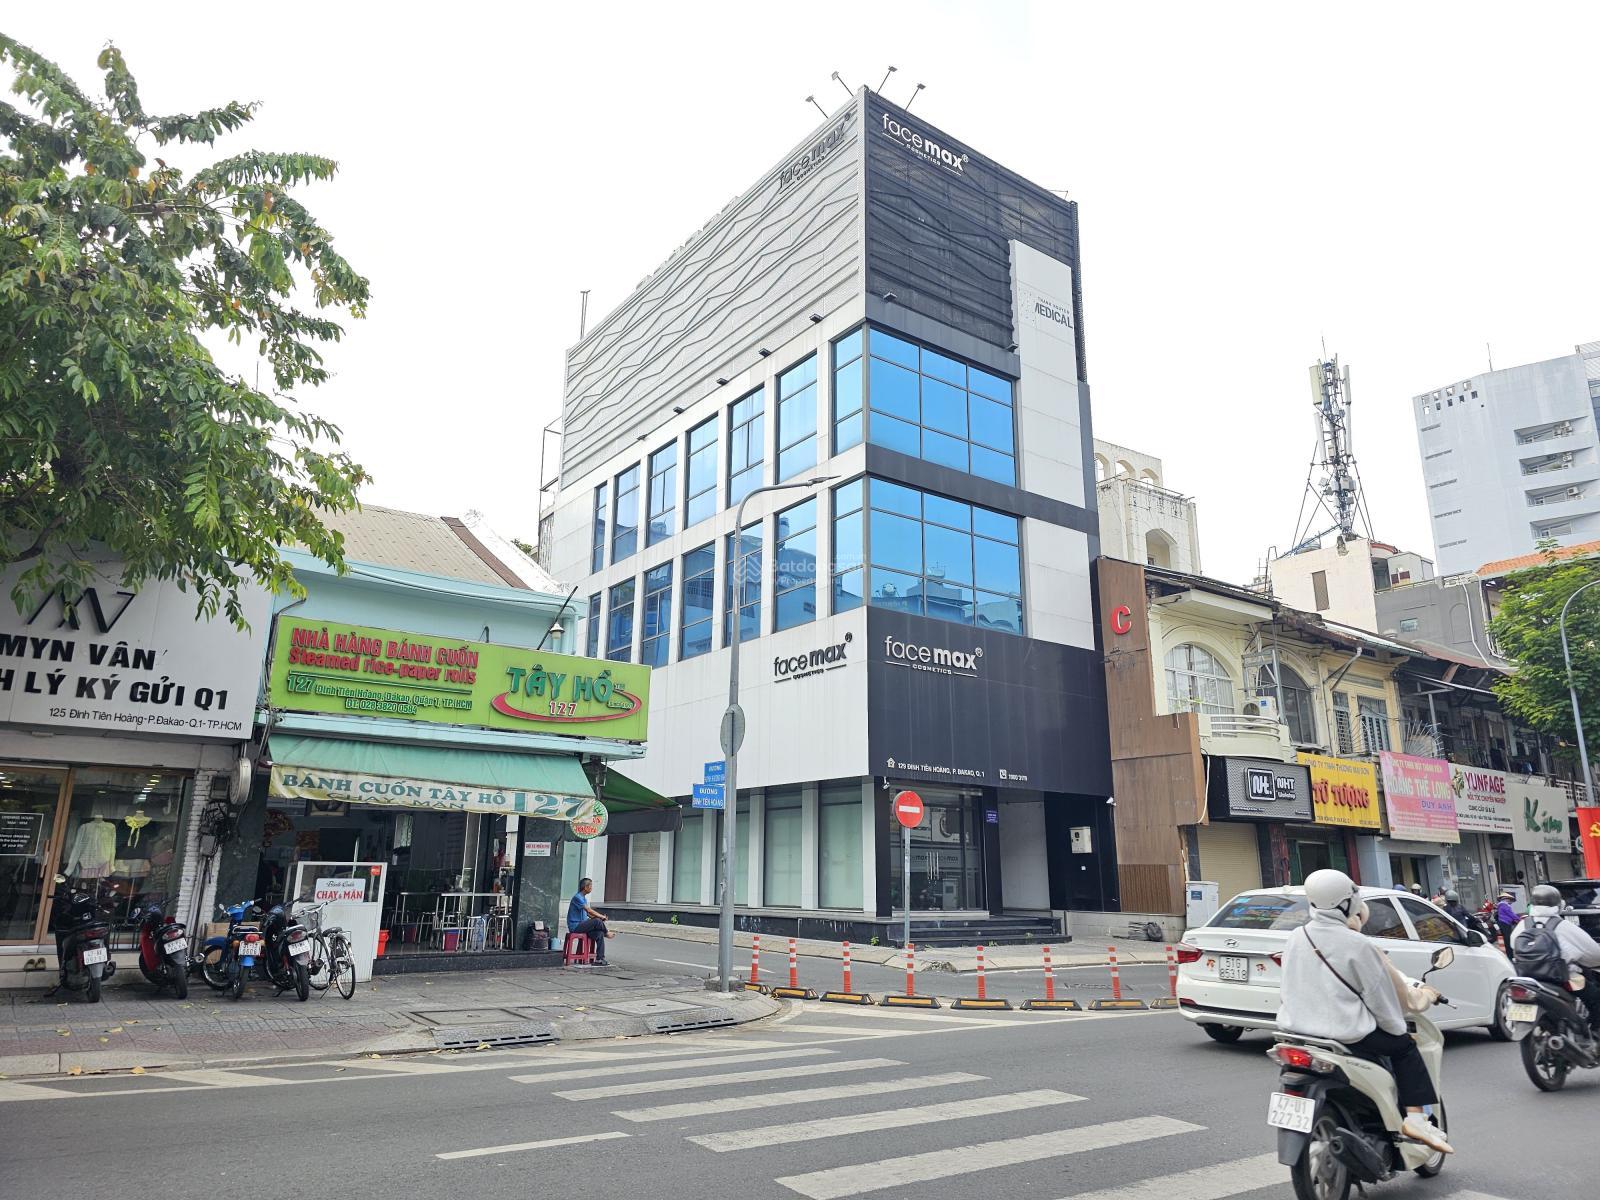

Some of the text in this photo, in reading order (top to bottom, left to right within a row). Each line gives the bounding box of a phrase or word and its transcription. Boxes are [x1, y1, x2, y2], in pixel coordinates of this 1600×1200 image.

[905, 143, 942, 167] COSMETICS
[1111, 605, 1132, 634] C
[89, 641, 156, 670] VÂN
[292, 627, 479, 669] NHÀ HÀNG BÁNH CUỐN
[289, 647, 476, 684] Steamed rice-paper rolls
[912, 663, 952, 675] COSMETICS
[24, 669, 67, 695] LÝ
[75, 674, 121, 700] KÝ
[129, 676, 185, 706] GỬI
[194, 688, 228, 711] Q1
[287, 674, 316, 693] 127
[507, 664, 566, 700] TÂY
[50, 708, 66, 718] 125
[92, 711, 112, 721] Tiên
[360, 699, 376, 711] 028
[377, 701, 397, 713] 3820
[398, 703, 417, 715] 0584
[550, 701, 577, 716] 127
[1276, 777, 1295, 790] NHT
[1464, 772, 1506, 794] YUNFAGE
[282, 773, 352, 791] BÁNH
[359, 780, 422, 799] CUỐN
[430, 787, 472, 805] TÂY
[478, 791, 506, 805] HỒ
[512, 792, 584, 818] 127
[316, 890, 338, 900] CHAY
[343, 888, 363, 901] MẶN
